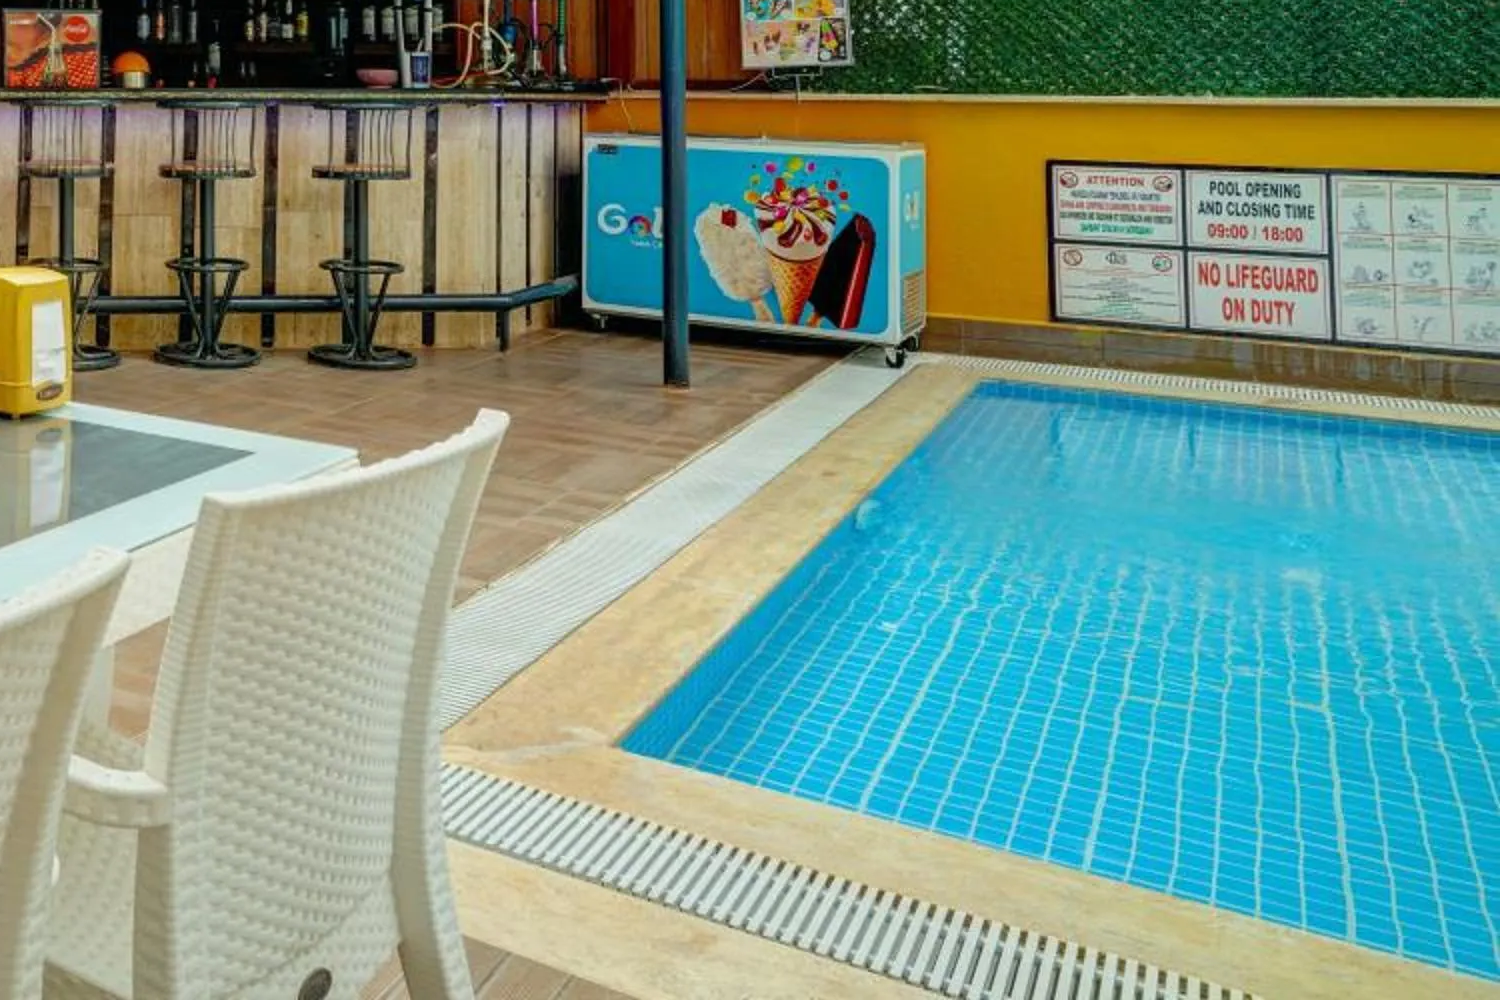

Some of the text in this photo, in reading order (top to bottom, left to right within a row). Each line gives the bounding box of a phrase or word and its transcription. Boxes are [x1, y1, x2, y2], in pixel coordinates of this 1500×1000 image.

[1087, 175, 1145, 187] ATTENTION
[1209, 181, 1301, 198] POOL OPENING
[1198, 200, 1316, 220] AND CLOSING TIME
[598, 203, 663, 239] Gol
[1207, 223, 1249, 239] 09:00
[1261, 226, 1303, 242] 18:00
[1198, 262, 1220, 287] NO
[1226, 263, 1319, 293] LIFEGUARD
[1222, 297, 1295, 326] ON DUTY
